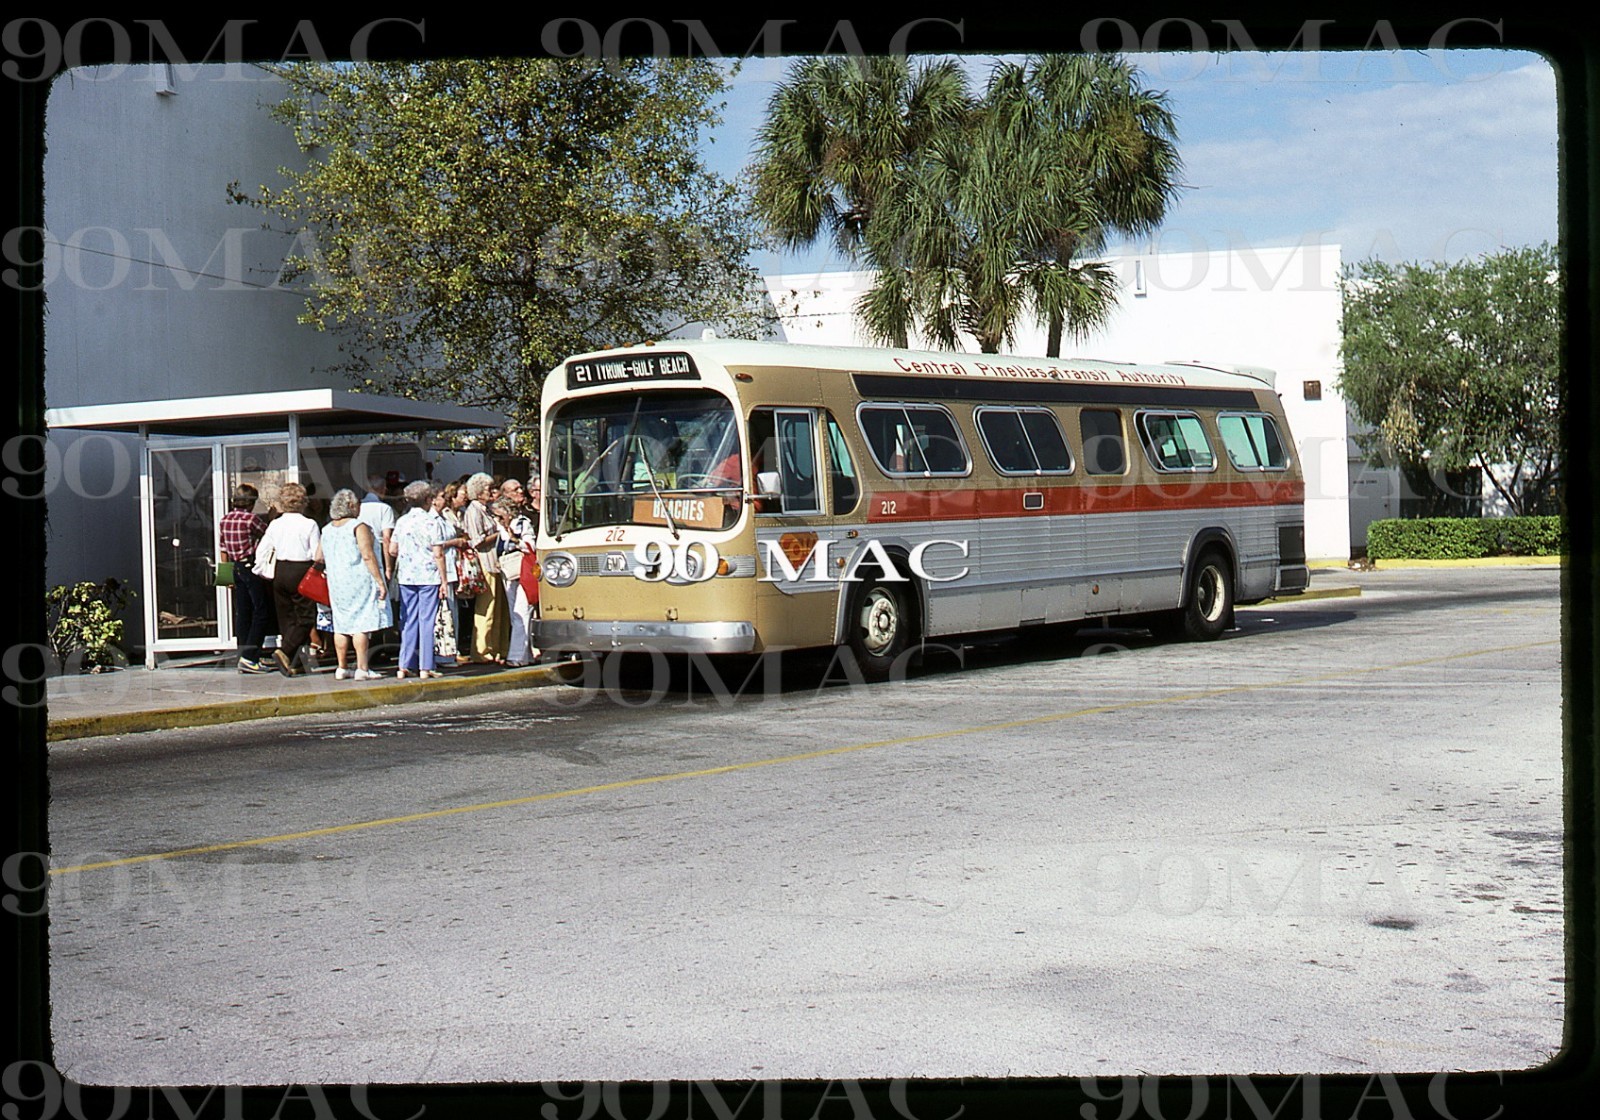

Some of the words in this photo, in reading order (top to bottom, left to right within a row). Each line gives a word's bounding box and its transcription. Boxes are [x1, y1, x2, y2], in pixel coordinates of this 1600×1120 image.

[575, 365, 592, 382] 21
[595, 359, 655, 381] TYRONE-GULF
[659, 356, 690, 375] BEACH
[893, 358, 967, 375] Central
[974, 362, 1047, 378] Pinellas
[1048, 366, 1110, 381] Transit
[1116, 370, 1186, 387] Authority
[881, 500, 897, 515] 212
[605, 529, 626, 542] 212
